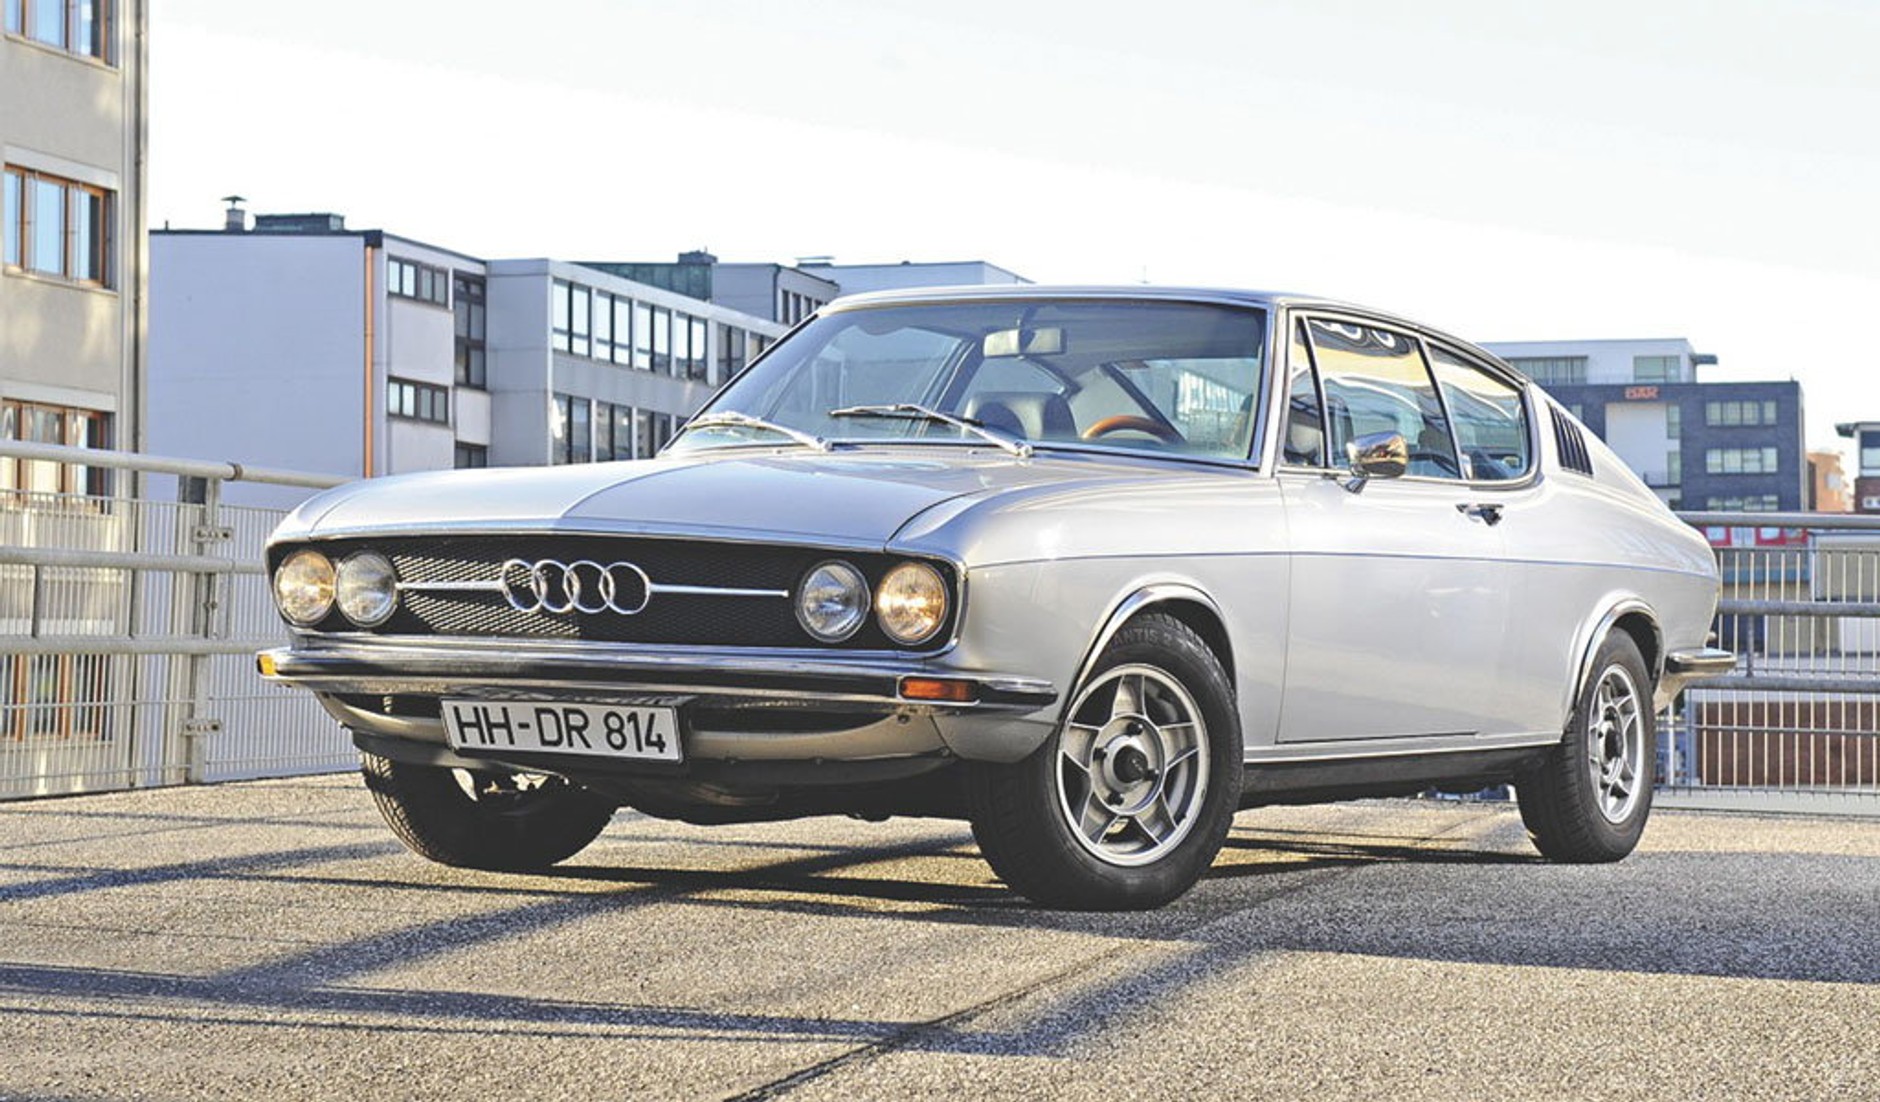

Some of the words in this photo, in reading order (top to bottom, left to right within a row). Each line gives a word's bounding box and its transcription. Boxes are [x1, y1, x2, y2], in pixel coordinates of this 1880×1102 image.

[1111, 627, 1158, 647] ANTIS
[453, 706, 592, 749] HH-DR
[603, 711, 666, 754] 814
